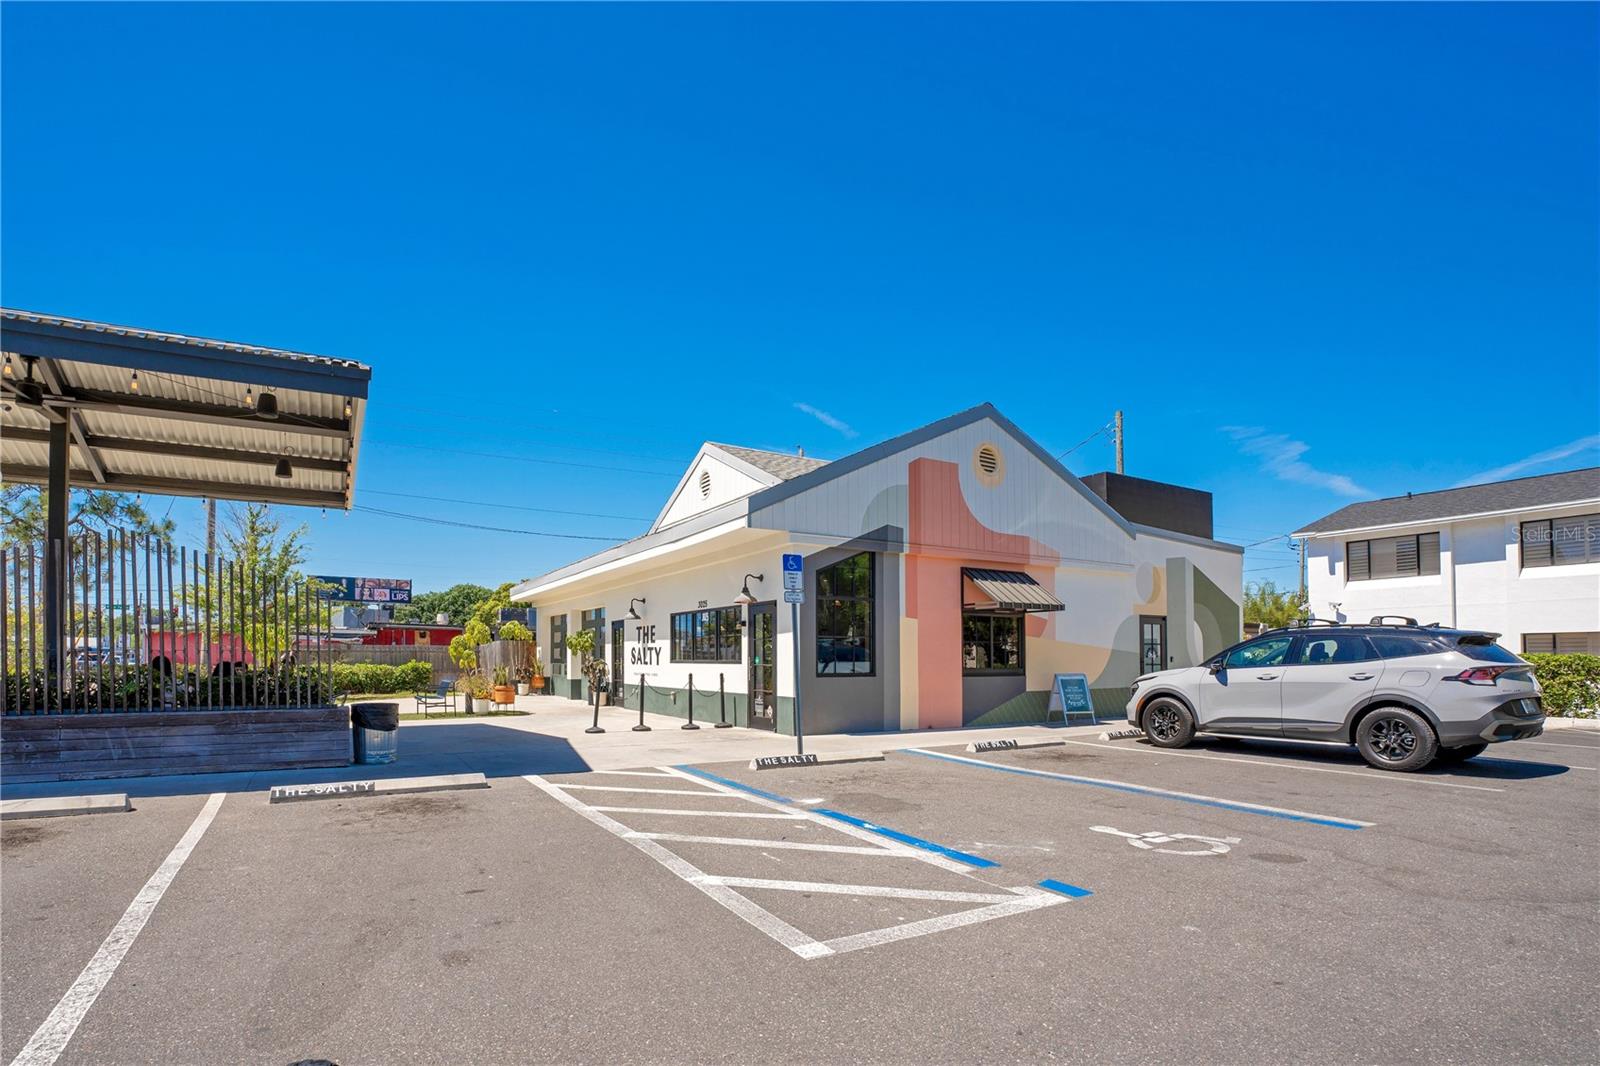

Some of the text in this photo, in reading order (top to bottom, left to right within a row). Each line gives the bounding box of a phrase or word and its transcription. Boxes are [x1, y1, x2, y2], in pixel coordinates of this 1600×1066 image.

[391, 592, 409, 601] LIPS
[636, 625, 656, 644] THE
[631, 646, 662, 666] SALTY
[757, 755, 815, 766] THE SALTY
[273, 780, 371, 798] THE SALTY
